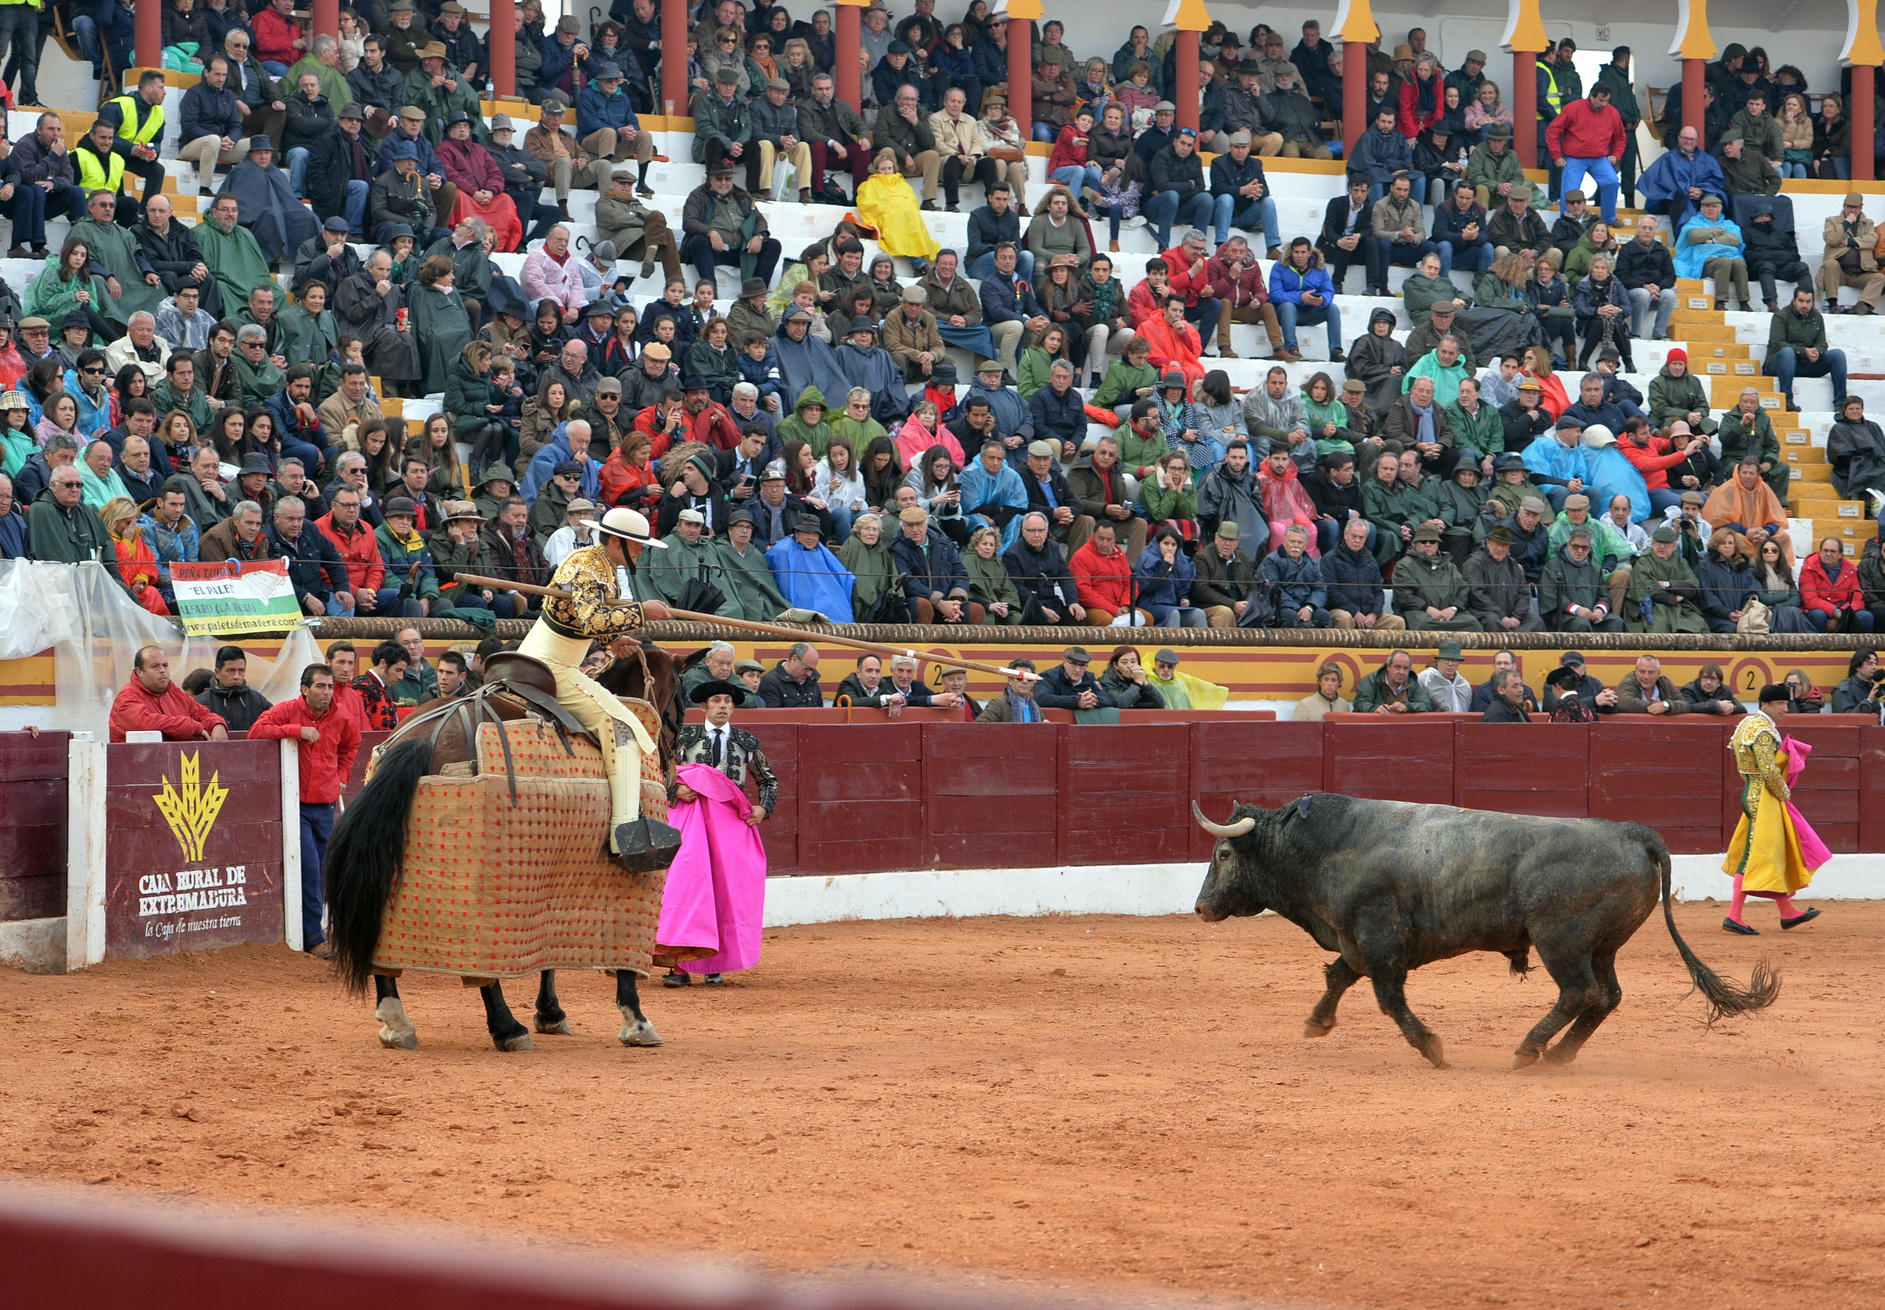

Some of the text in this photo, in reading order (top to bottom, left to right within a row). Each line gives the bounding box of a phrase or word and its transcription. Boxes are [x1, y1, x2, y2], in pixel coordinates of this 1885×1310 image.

[179, 566, 201, 578] PEÑA
[933, 664, 942, 686] 2
[1746, 670, 1755, 690] 2
[138, 866, 247, 895] CAJA RURAL DE
[138, 887, 247, 917] EXTREMADURA
[145, 914, 241, 941] la Caja de nuestra tierra
